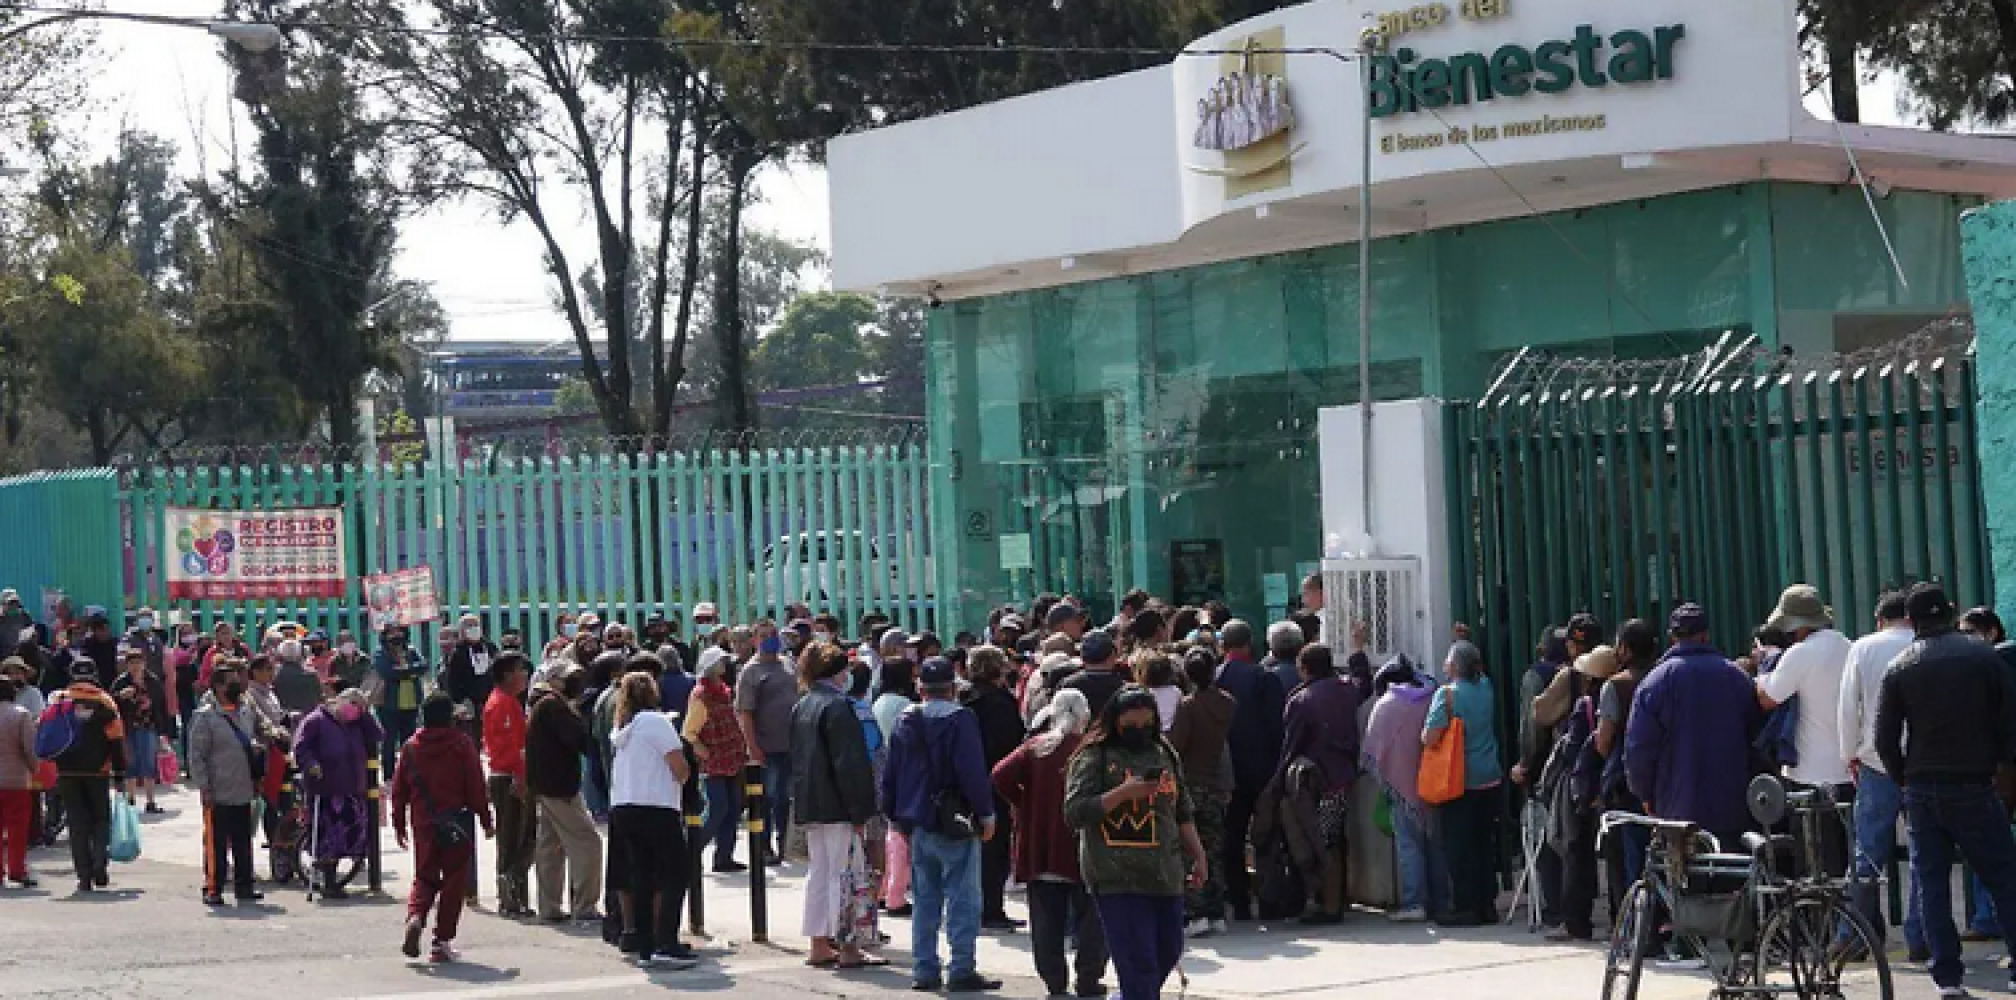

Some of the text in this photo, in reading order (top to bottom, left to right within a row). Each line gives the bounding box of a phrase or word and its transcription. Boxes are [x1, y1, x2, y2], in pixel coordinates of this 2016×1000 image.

[1370, 23, 1685, 118] Bienestar
[1380, 113, 1607, 153] El banco de los mexicanos
[240, 516, 336, 533] REGISTRO
